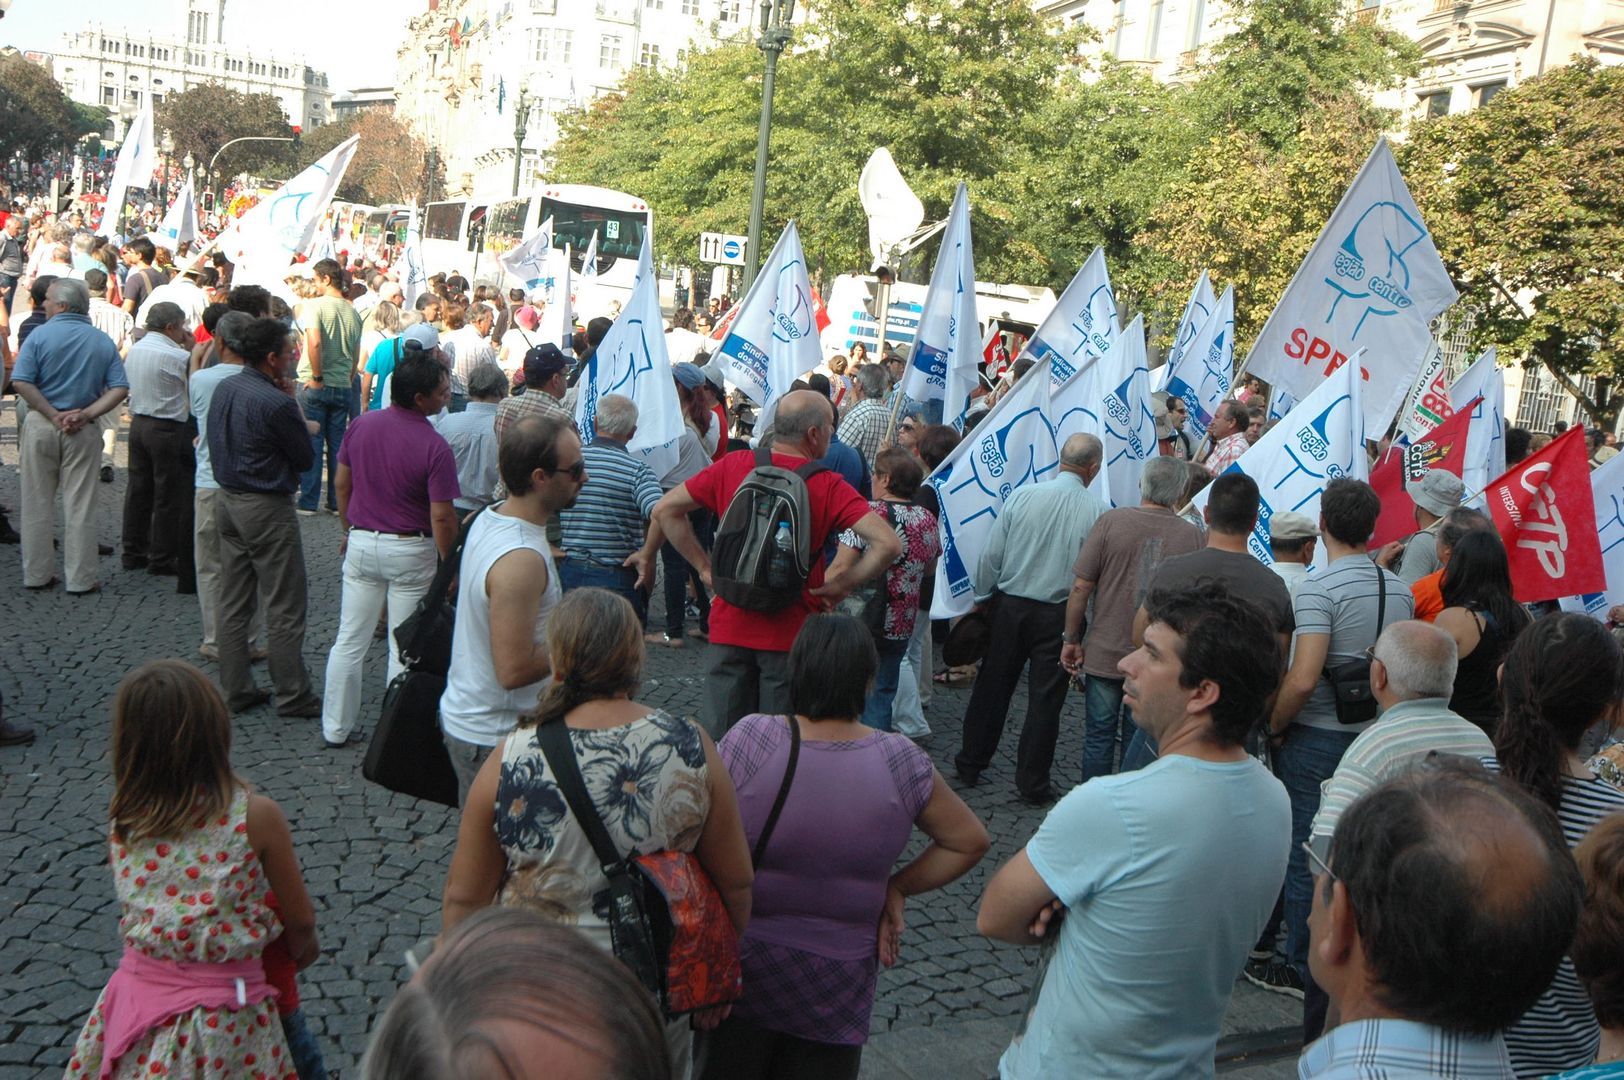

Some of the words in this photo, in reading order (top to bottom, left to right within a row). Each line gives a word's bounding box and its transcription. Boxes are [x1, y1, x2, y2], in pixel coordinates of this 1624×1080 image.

[608, 222, 618, 232] 43
[1334, 253, 1365, 281] egião
[1367, 275, 1412, 308] centro
[777, 313, 801, 339] centro
[731, 361, 742, 372] da
[737, 351, 752, 365] dos
[1050, 352, 1077, 376] indicato
[1283, 327, 1370, 382] SPR
[1103, 394, 1130, 426] região
[1412, 411, 1438, 433] cent
[980, 434, 1004, 478] região
[1296, 426, 1328, 461] região
[1411, 444, 1422, 477] CGTP
